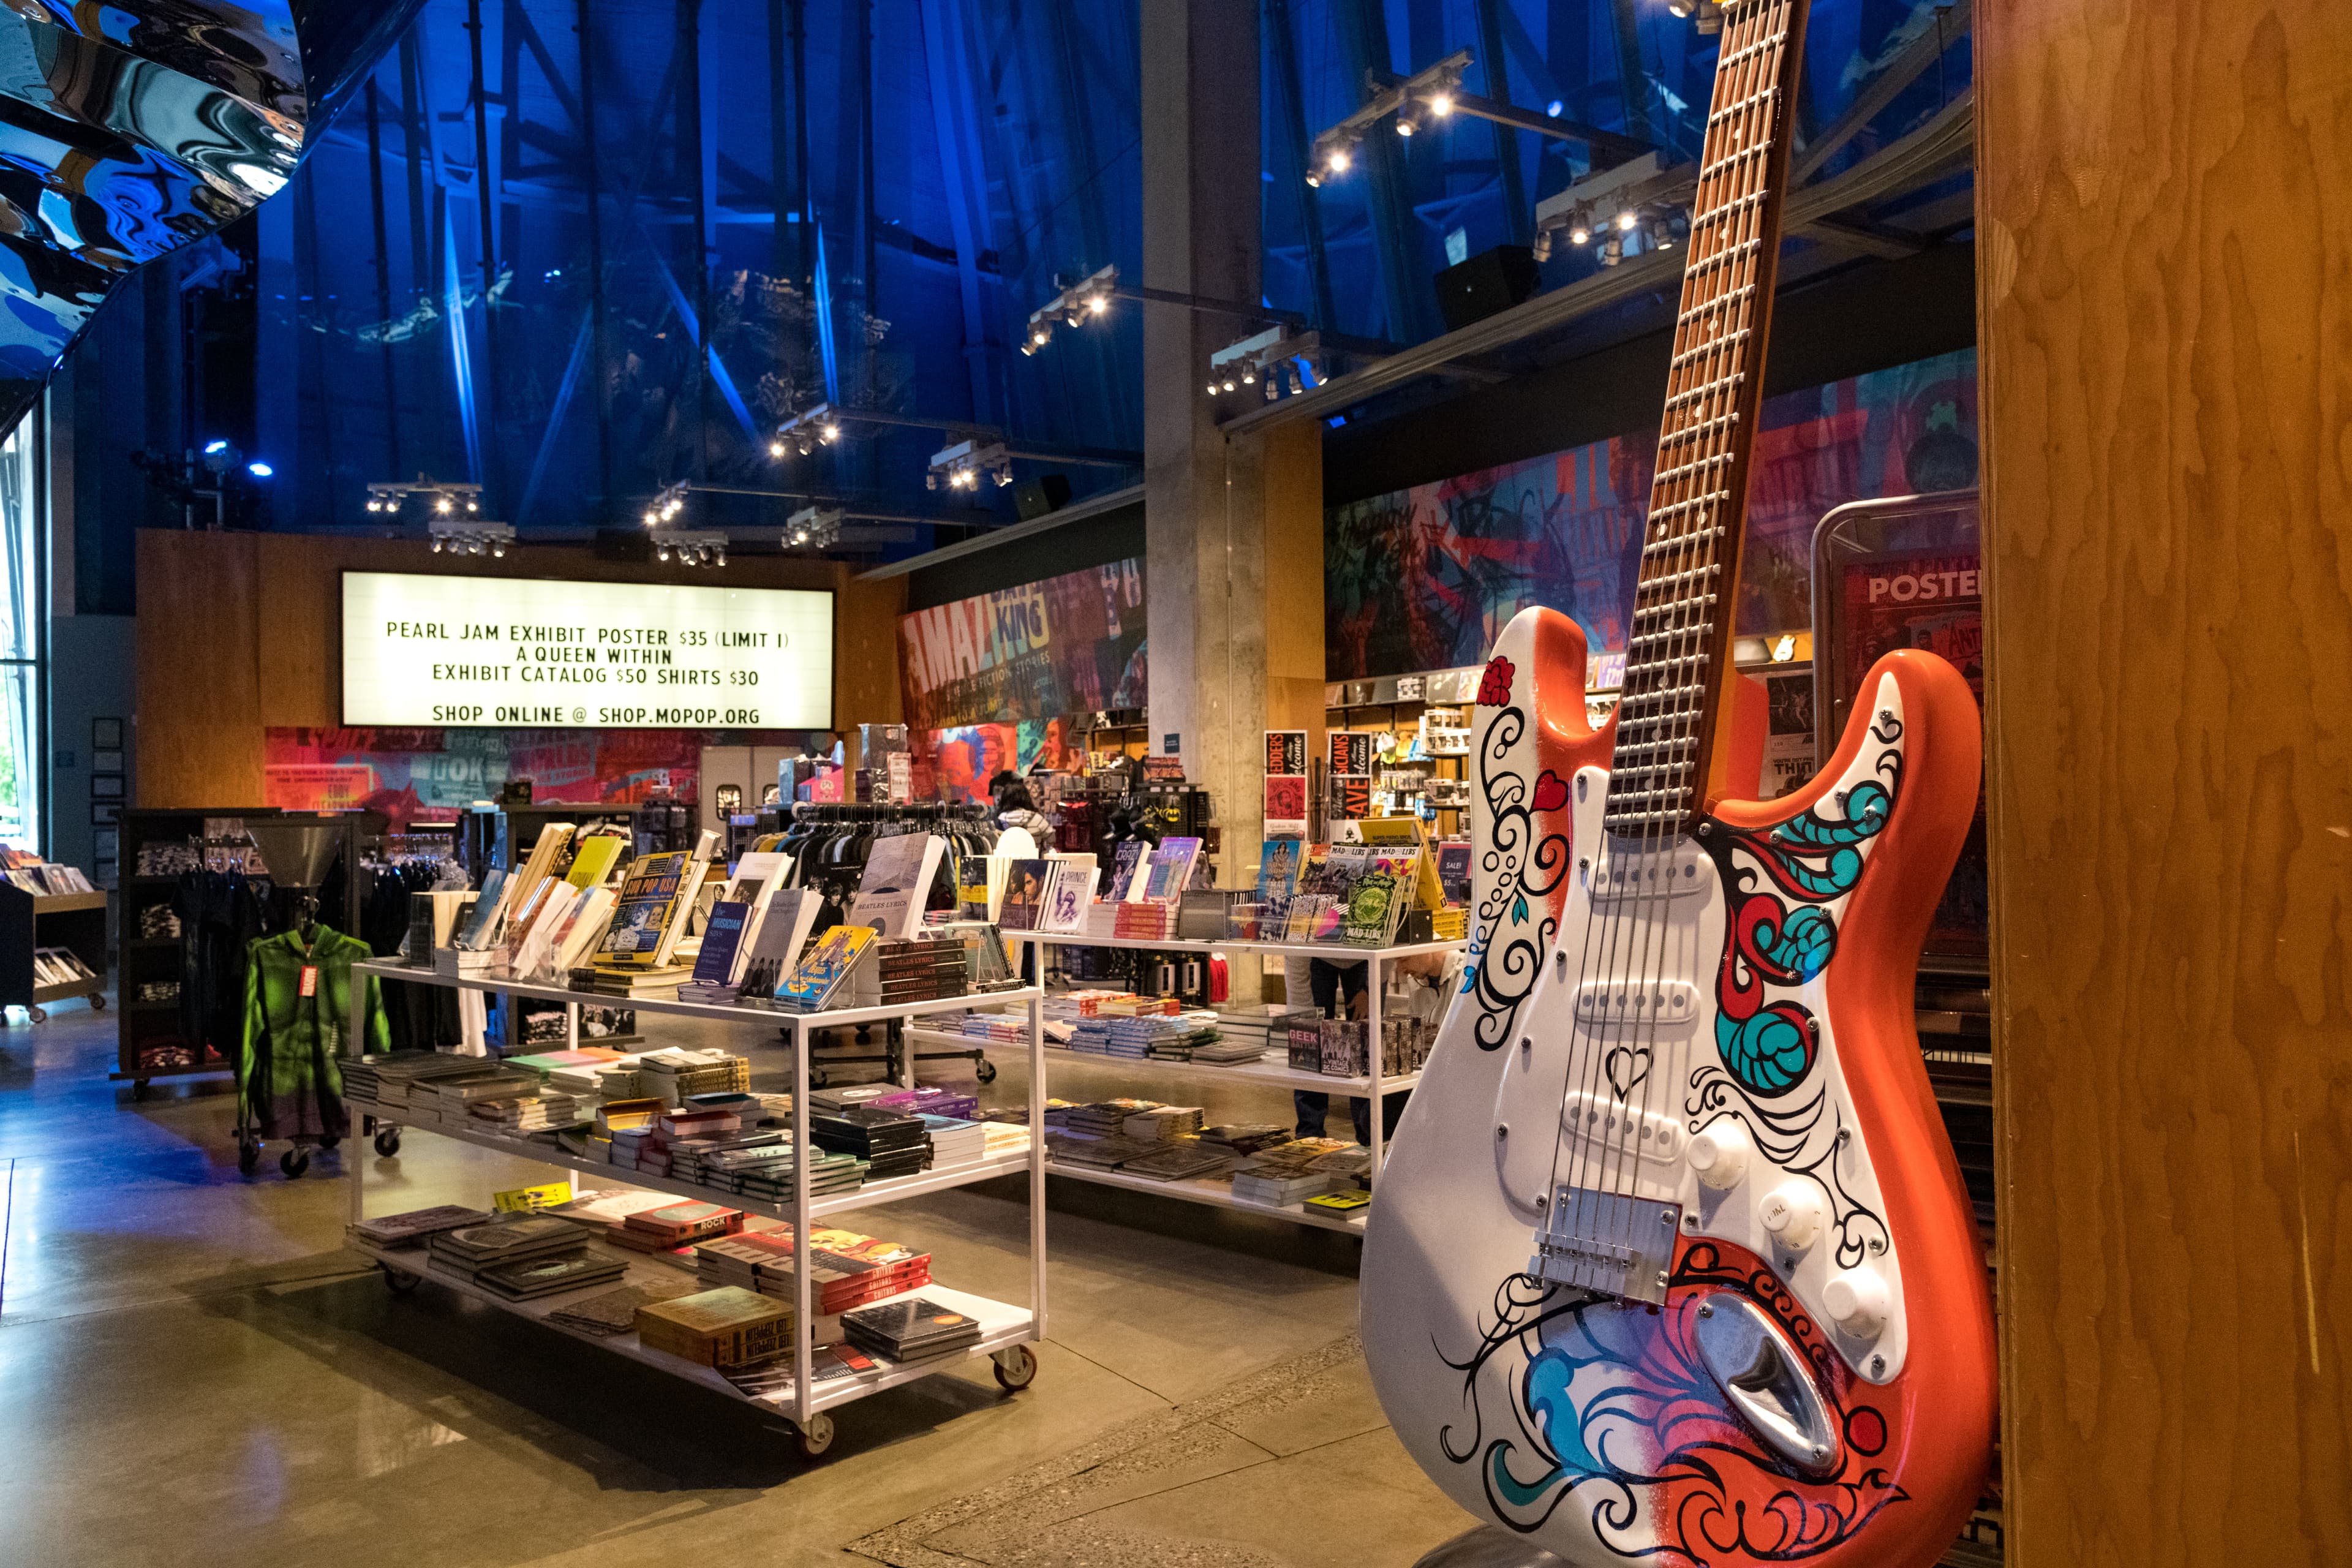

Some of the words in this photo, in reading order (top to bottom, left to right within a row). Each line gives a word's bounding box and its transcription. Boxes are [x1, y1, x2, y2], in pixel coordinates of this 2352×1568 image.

[996, 599, 1042, 643] KING
[388, 622, 449, 638] PEARL
[461, 624, 498, 640] JAM
[511, 626, 586, 643] EXHIBIT
[599, 628, 667, 645] POSTER
[679, 631, 707, 646] $35
[715, 631, 767, 647] (LIMIT
[516, 646, 527, 661] A
[535, 647, 595, 662] QUEEN
[608, 649, 671, 664] WITHIN
[434, 665, 511, 681] EXHIBIT
[521, 666, 606, 682] CATALOG
[617, 669, 646, 683] $50
[658, 669, 720, 685] SHIRTS
[730, 671, 758, 685] $30
[433, 706, 483, 720] SHOP
[496, 707, 562, 722] ONLINE
[573, 707, 586, 722] @
[600, 708, 759, 723] SHOP.MOPOP.ORG
[1116, 849, 1141, 861] CRAZY
[1065, 871, 1088, 884] PRINCE
[626, 879, 643, 895] SUB
[641, 878, 659, 894] POP
[659, 876, 677, 892] USA
[1270, 881, 1286, 889] MAD
[711, 918, 742, 930] MUSICIAN
[1347, 928, 1364, 938] MAD
[1365, 929, 1382, 940] LIBS
[914, 942, 934, 951] LYRICS
[888, 957, 914, 966] BEATLES
[888, 970, 914, 979] BEATLES
[915, 968, 937, 977] LYRICS
[890, 981, 916, 990] BEATLES
[917, 980, 938, 989] LYRICS
[889, 993, 916, 1003] BEATLES
[916, 992, 937, 1001] LYRICS
[1289, 1029, 1317, 1042] GEEK
[701, 1217, 726, 1230] ROCK
[872, 1265, 895, 1279] GUITARS
[869, 1276, 892, 1290] GUITARS
[873, 1286, 897, 1300] GUITARS
[745, 1321, 774, 1343] ZEPPELIN
[747, 1337, 777, 1359] ZEPPELIN
